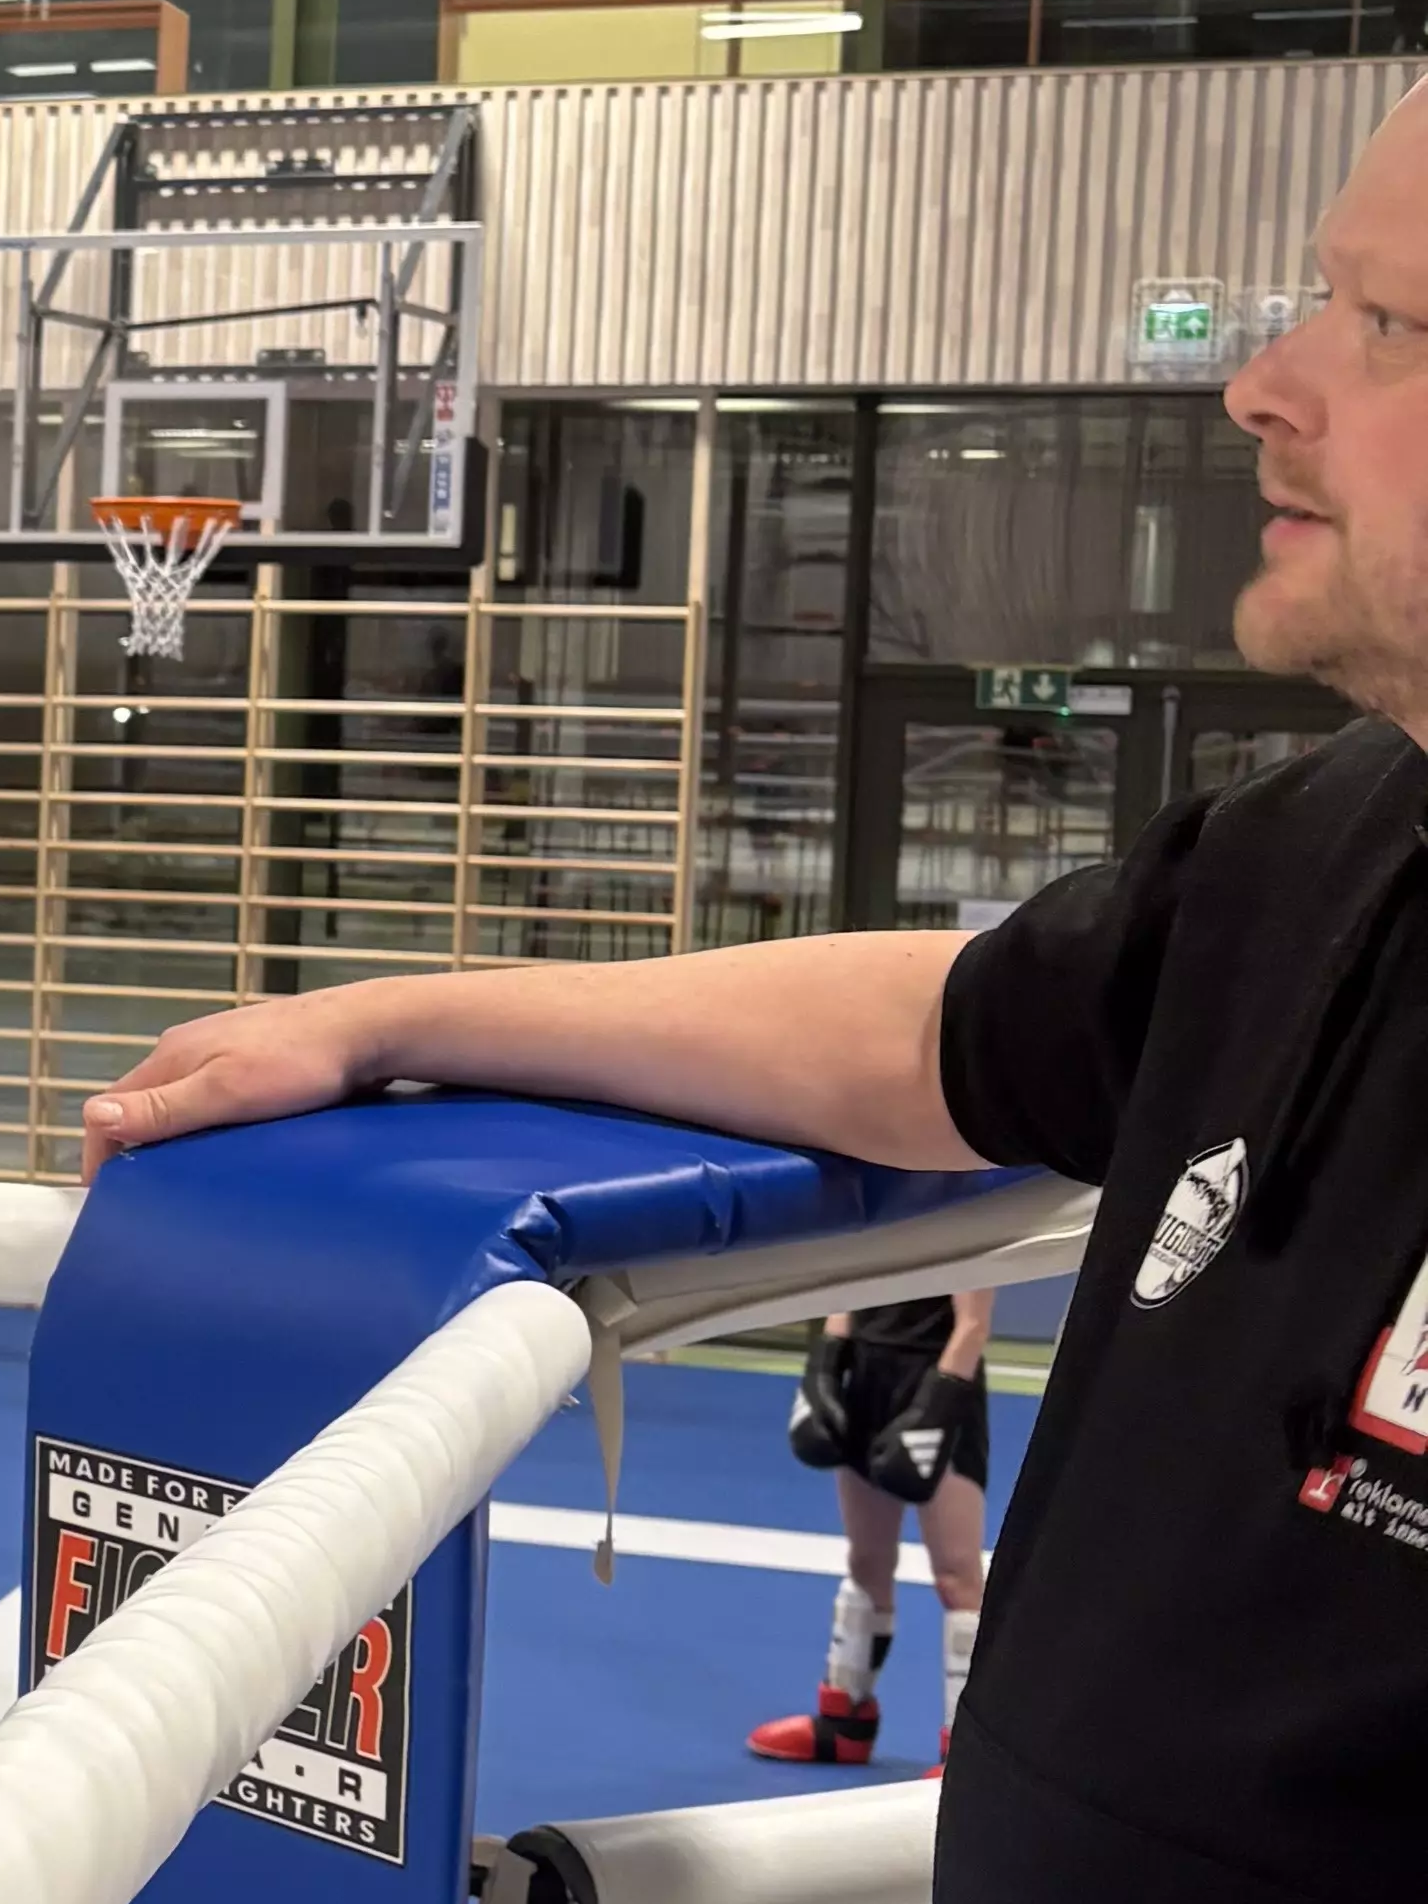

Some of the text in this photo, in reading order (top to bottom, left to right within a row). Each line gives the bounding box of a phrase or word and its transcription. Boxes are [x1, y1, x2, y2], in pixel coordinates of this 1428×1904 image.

[49, 1450, 134, 1490] MADE
[147, 1475, 210, 1510] FOR
[224, 1780, 376, 1843] GHTERS
